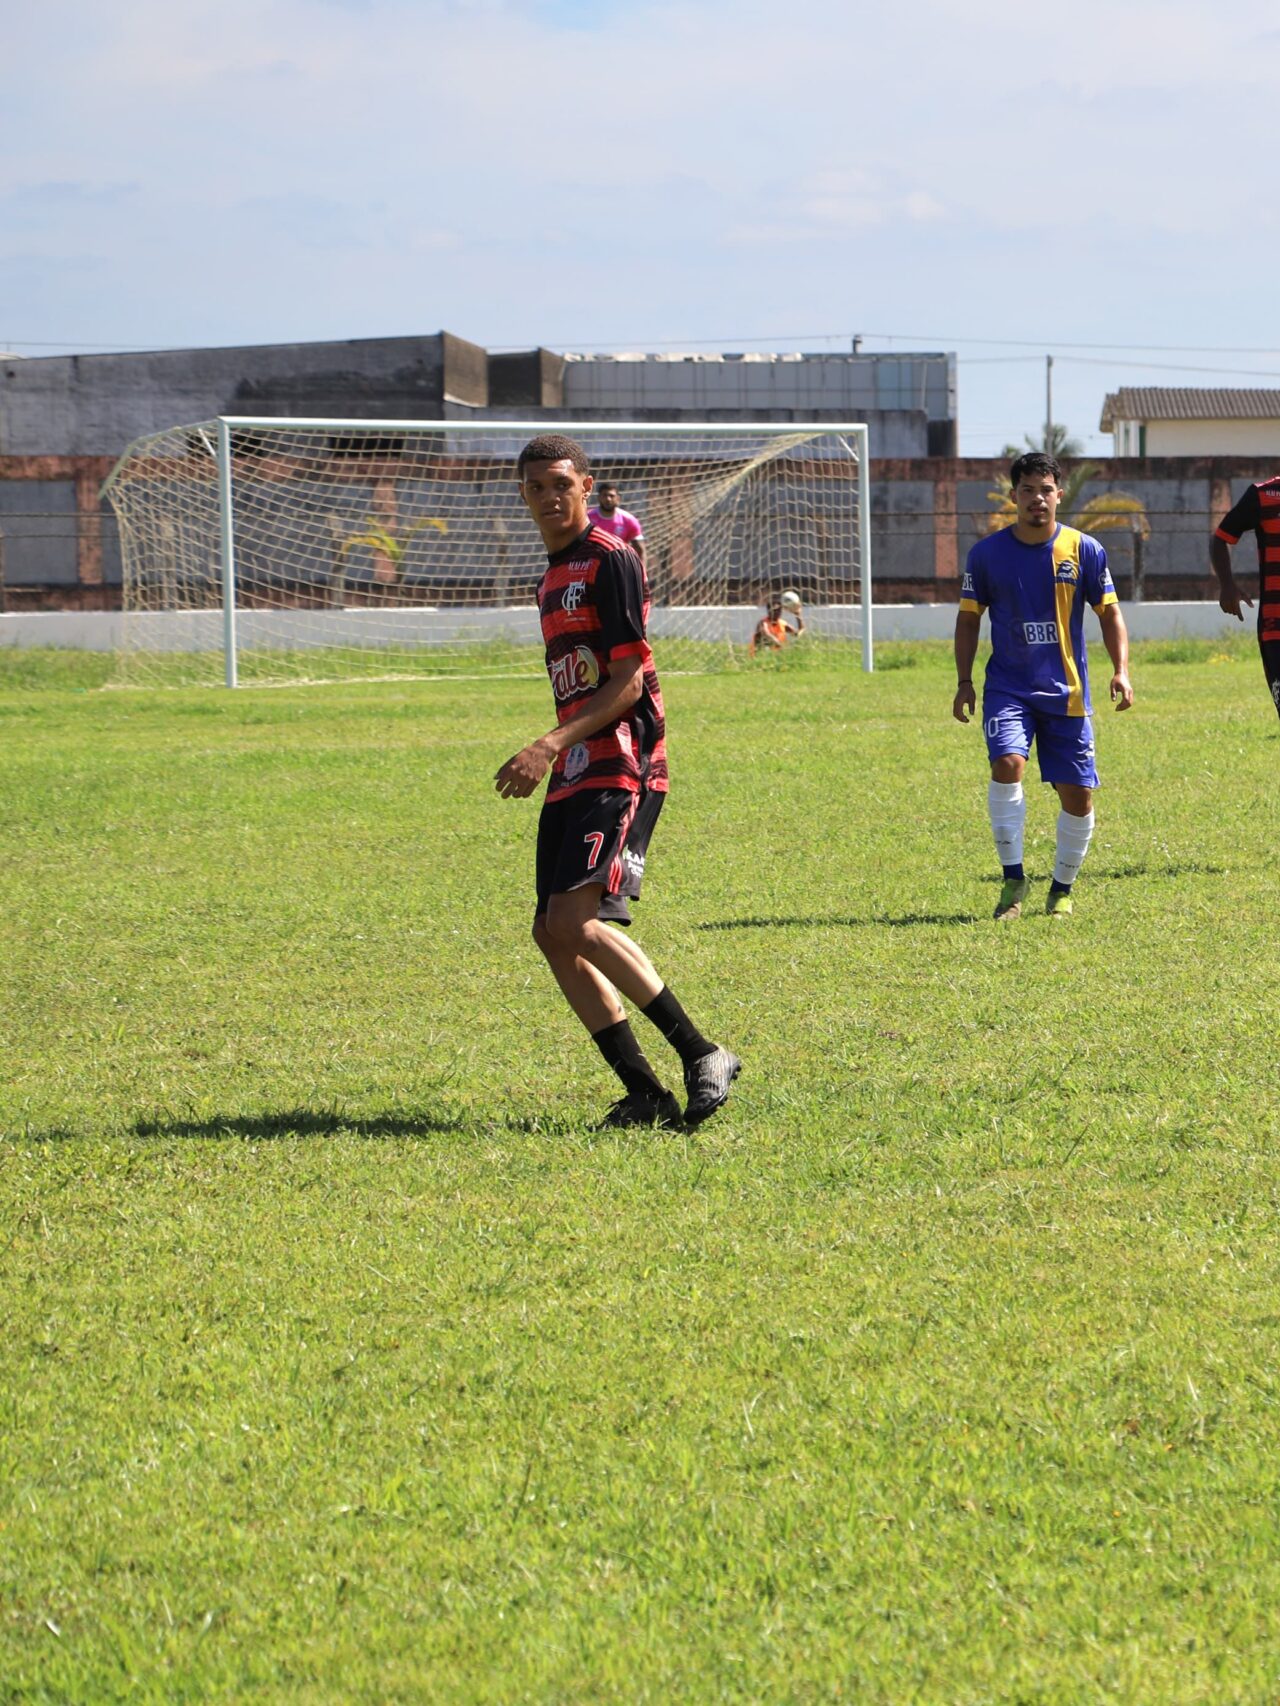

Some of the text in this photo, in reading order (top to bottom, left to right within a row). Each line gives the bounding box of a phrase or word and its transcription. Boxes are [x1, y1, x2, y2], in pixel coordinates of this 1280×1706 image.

[1025, 623, 1058, 643] BBR
[549, 652, 592, 700] ale
[584, 831, 605, 870] 7
